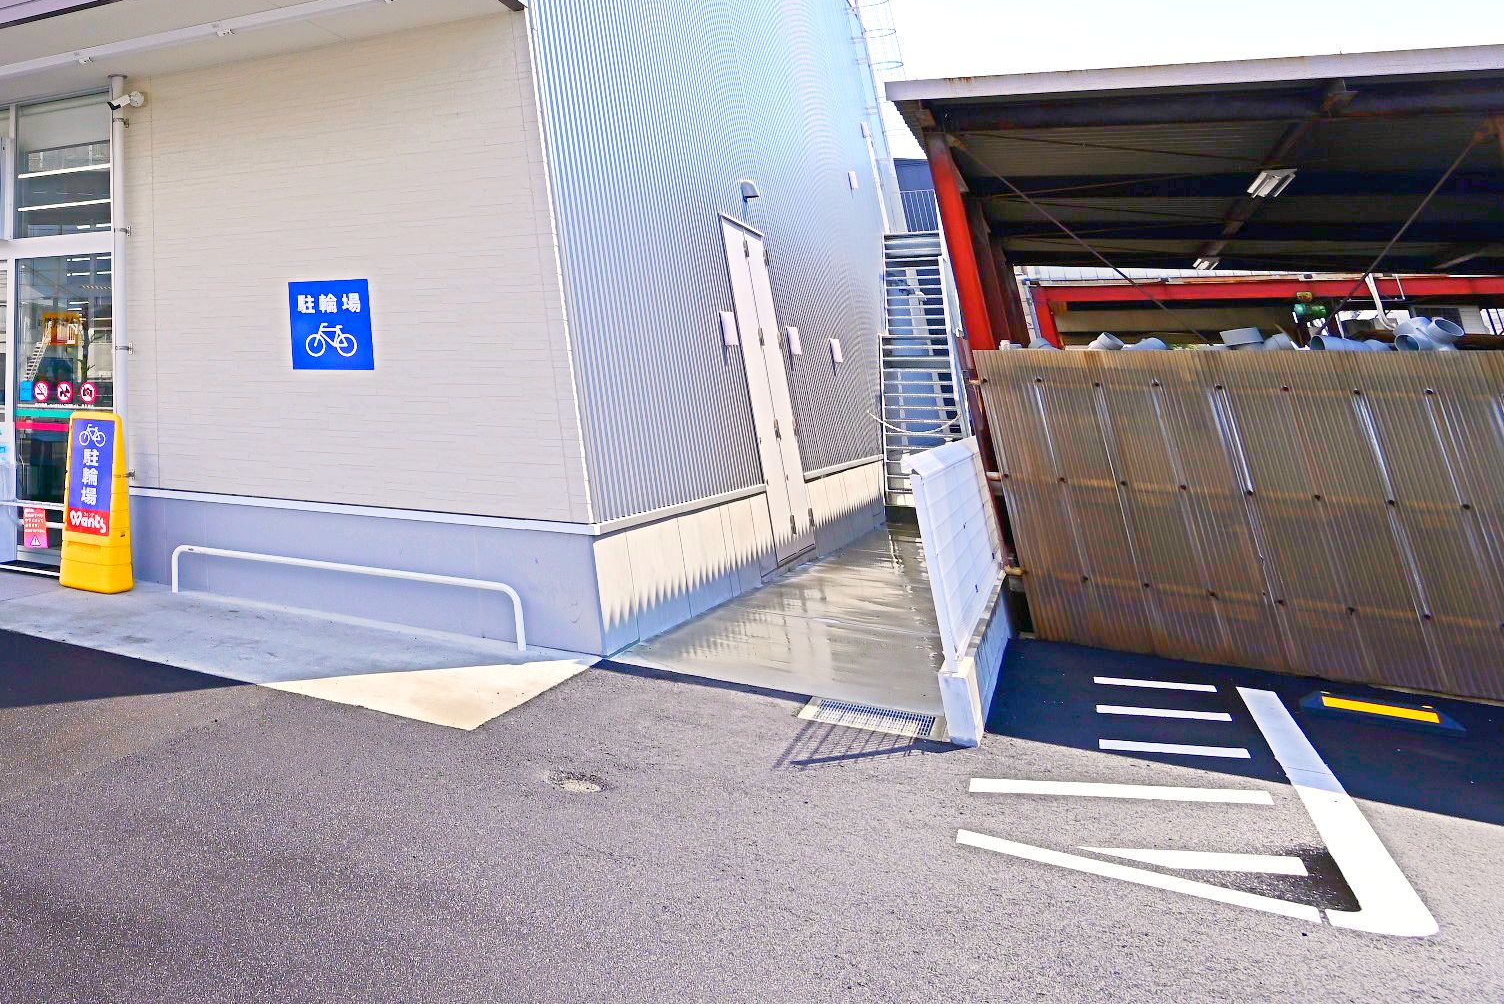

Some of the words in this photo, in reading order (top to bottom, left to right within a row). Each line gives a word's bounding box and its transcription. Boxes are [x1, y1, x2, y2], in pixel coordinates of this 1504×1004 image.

[297, 292, 361, 314] 駐輪場
[80, 448, 100, 506] 駐輪場
[69, 509, 107, 533] Wants
